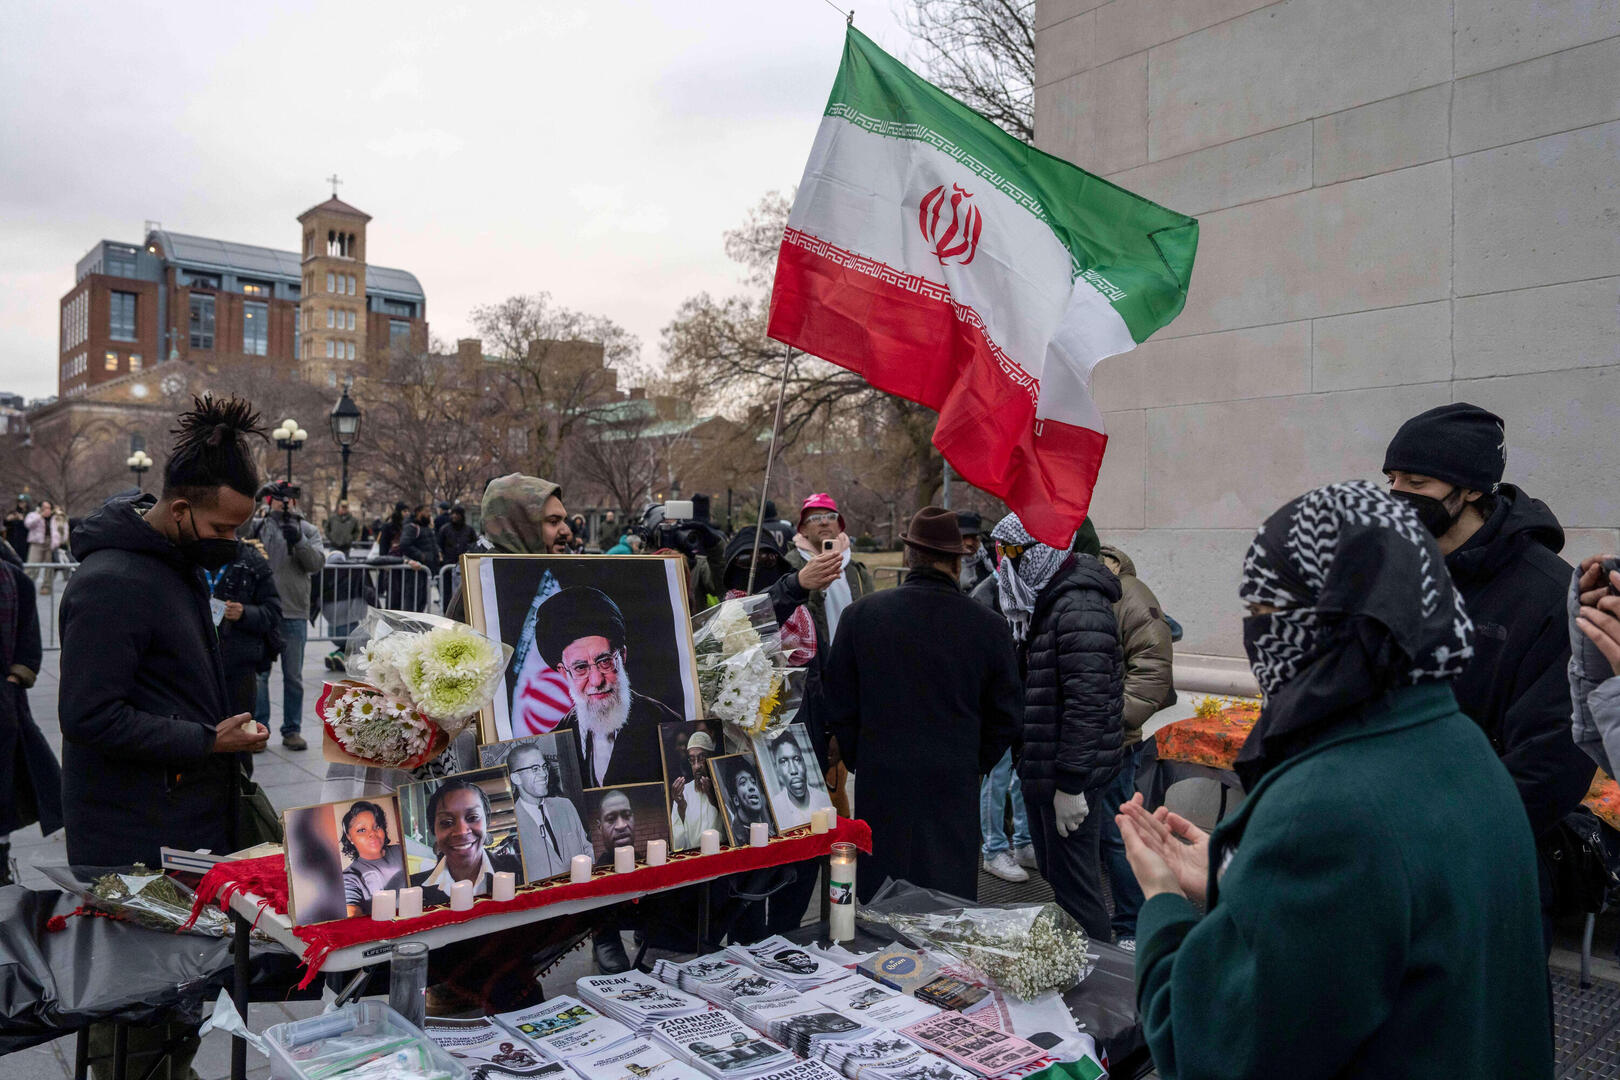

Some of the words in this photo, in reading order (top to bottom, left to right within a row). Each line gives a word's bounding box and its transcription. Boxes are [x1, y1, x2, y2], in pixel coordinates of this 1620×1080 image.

[589, 977, 631, 987] BREAK
[640, 1001, 687, 1010] CHAINS
[658, 1011, 723, 1030] ZIONISM
[666, 1024, 689, 1034] AND
[690, 1016, 728, 1028] RACIST
